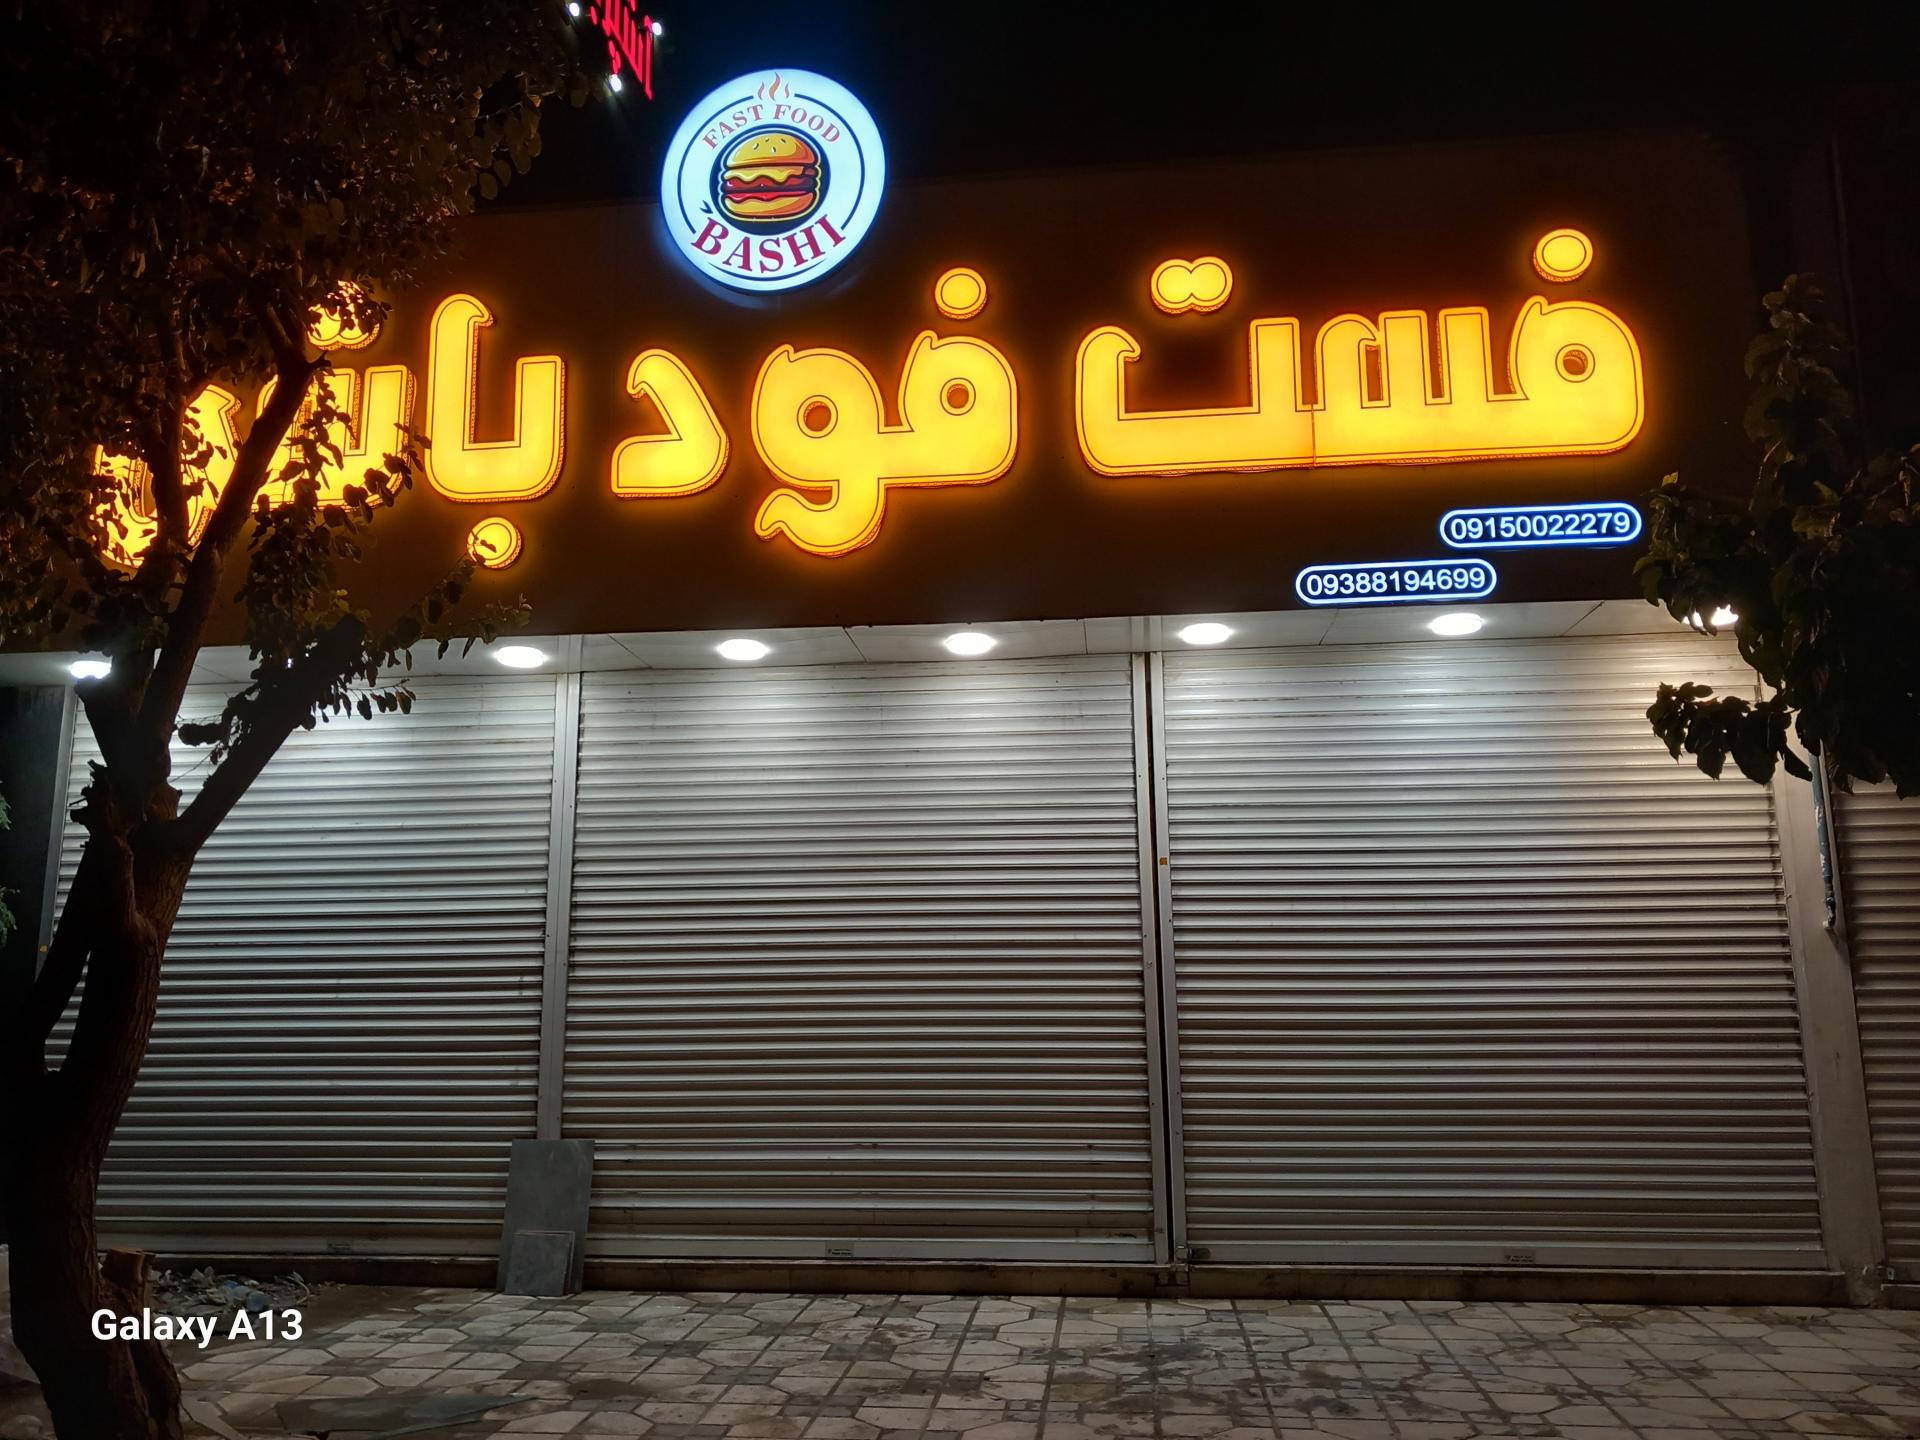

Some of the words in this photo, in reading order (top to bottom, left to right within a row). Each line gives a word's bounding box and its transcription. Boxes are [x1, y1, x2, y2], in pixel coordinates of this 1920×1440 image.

[702, 103, 764, 150] FAST
[773, 103, 841, 144] FOOD
[690, 213, 847, 274] BASHI
[1075, 228, 1645, 476] فست
[611, 267, 1018, 557] فود
[1450, 511, 1632, 541] 09150022279
[1306, 566, 1486, 597] 09388194699
